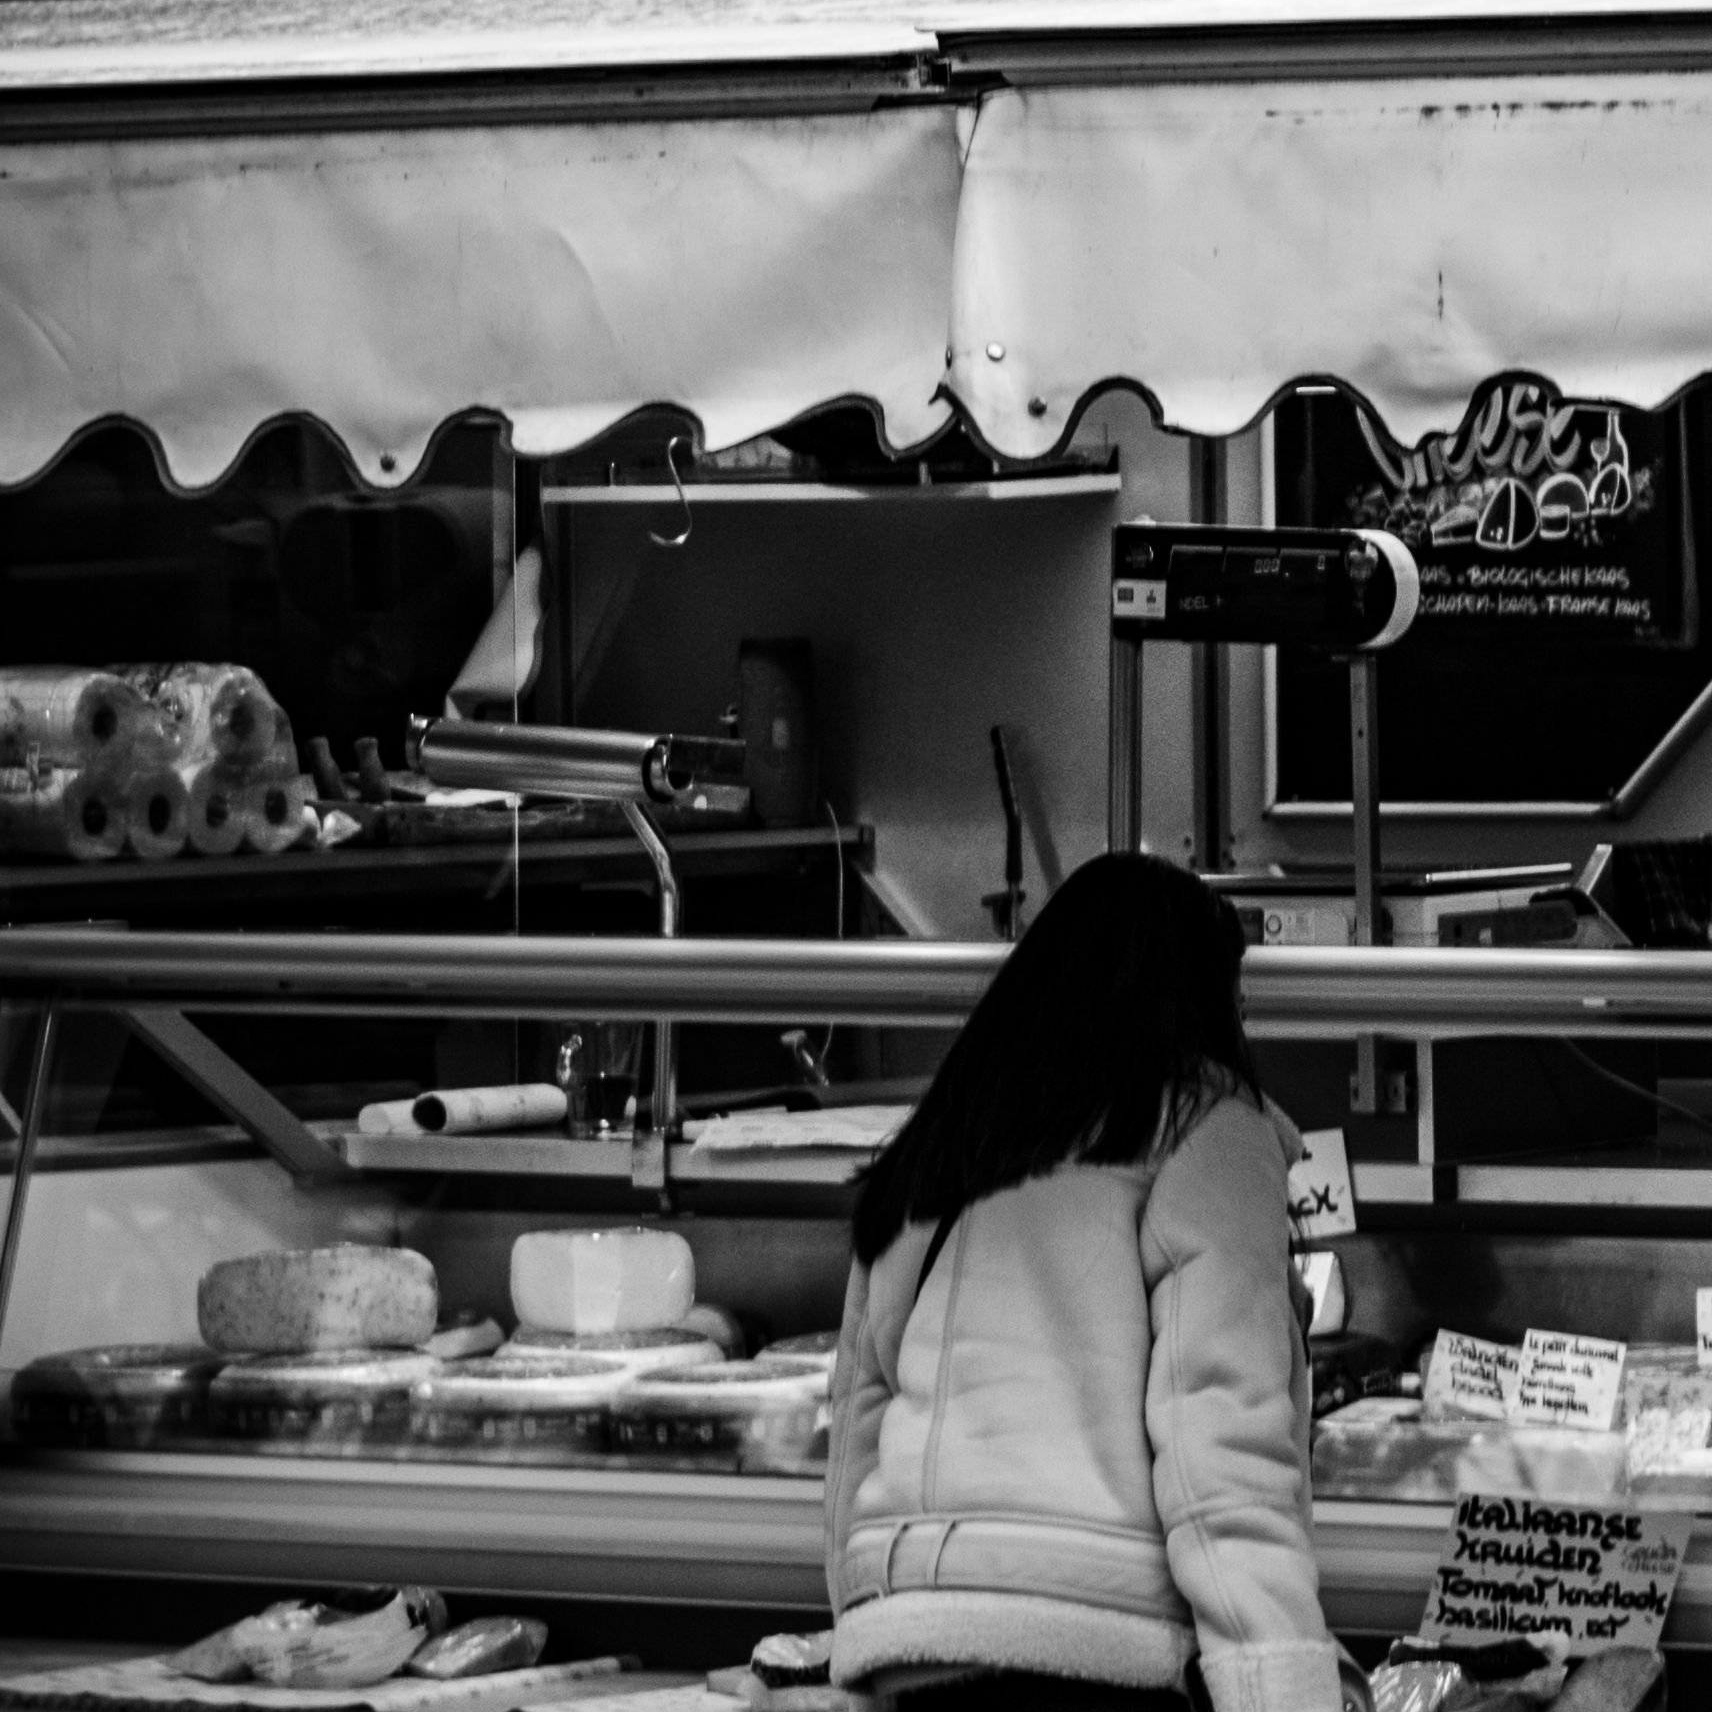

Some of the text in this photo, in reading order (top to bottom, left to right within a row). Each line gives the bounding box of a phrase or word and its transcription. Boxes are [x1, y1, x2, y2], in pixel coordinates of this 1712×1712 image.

[1467, 564, 1581, 588] BIOLOGISCHE
[1584, 565, 1630, 589] KAAS
[1614, 596, 1651, 621] KAAS
